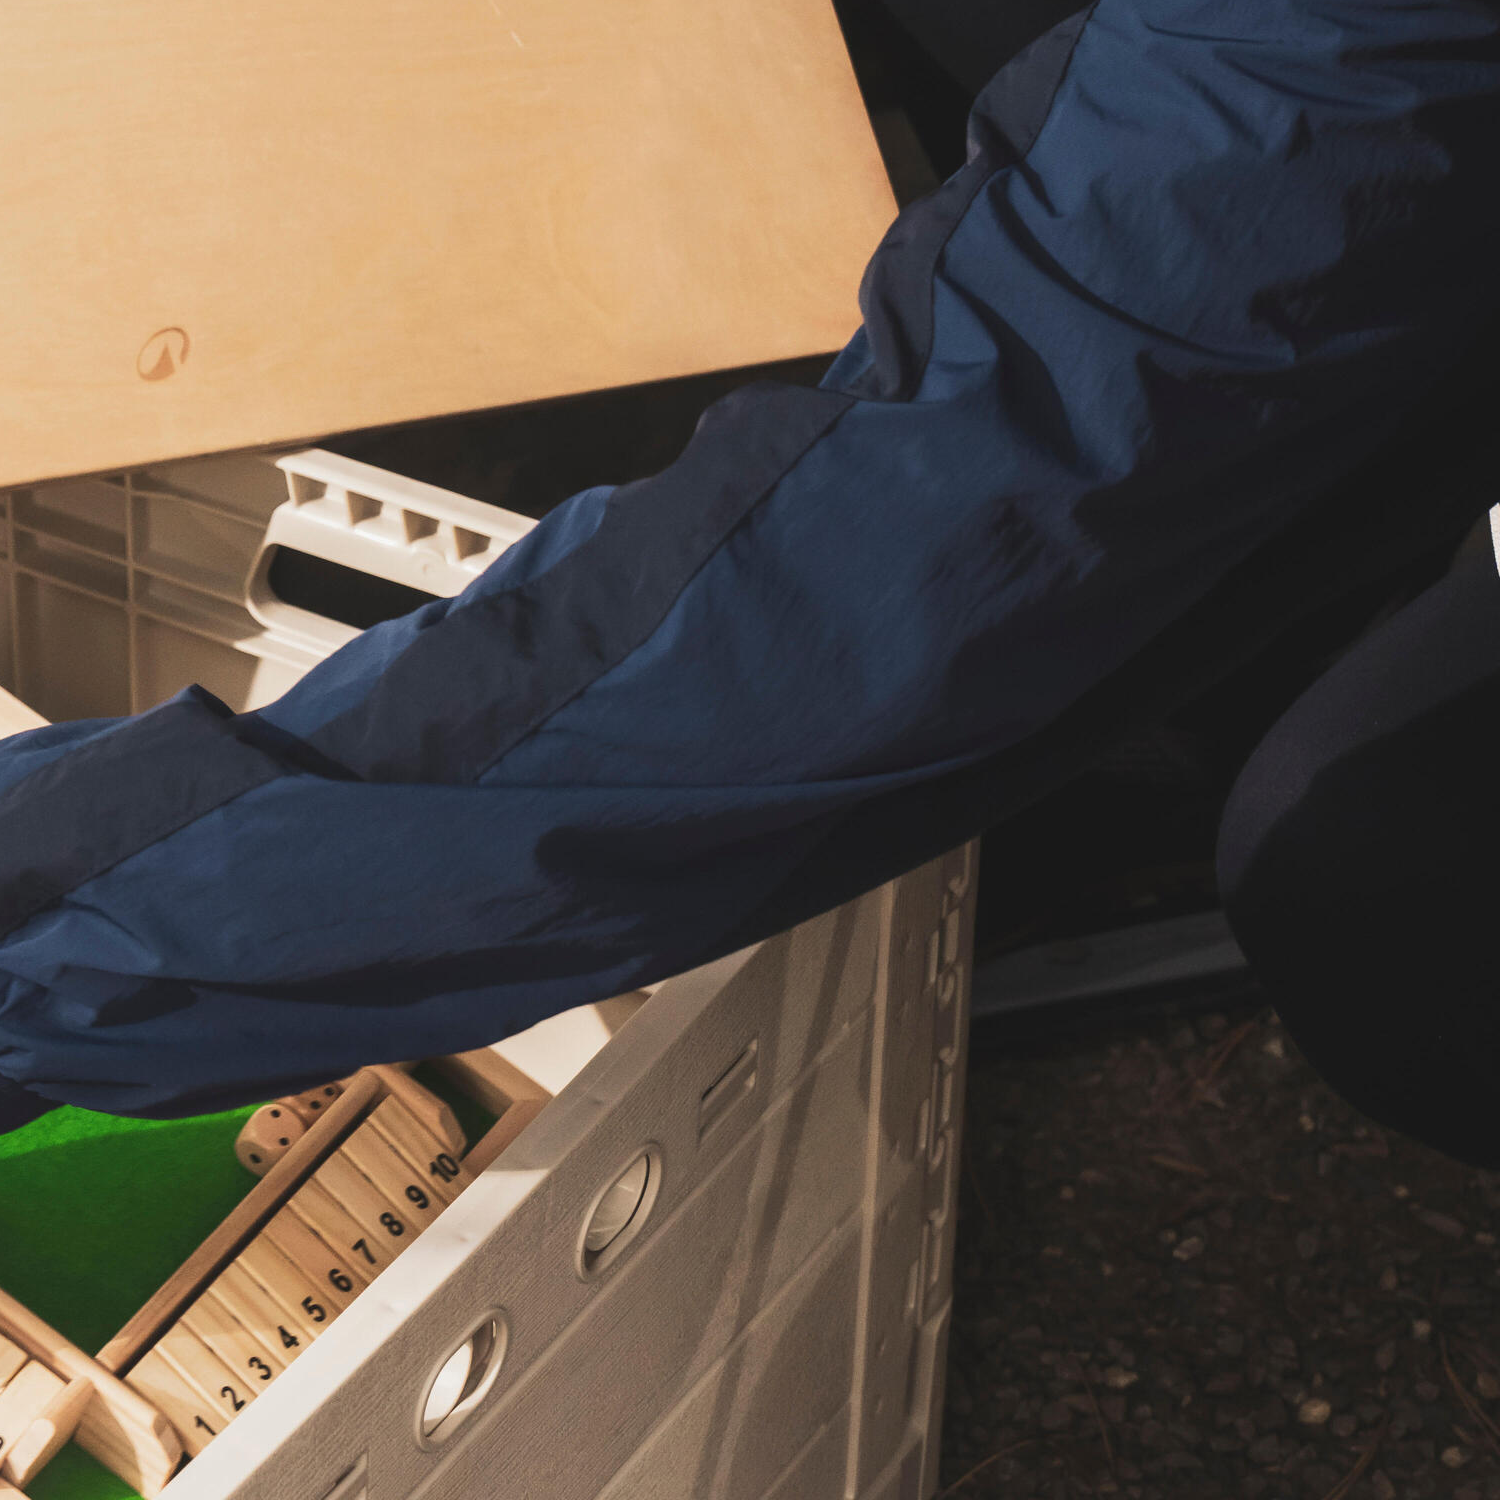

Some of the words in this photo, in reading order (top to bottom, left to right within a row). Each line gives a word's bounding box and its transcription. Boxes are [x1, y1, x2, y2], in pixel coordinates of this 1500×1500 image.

[194, 1415, 217, 1436] 1
[220, 1385, 246, 1412] 2
[248, 1356, 273, 1381] 3
[277, 1325, 300, 1350] 4
[300, 1296, 327, 1323] 5
[328, 1268, 354, 1293] 6
[352, 1238, 377, 1265] 7
[380, 1211, 405, 1237] 8
[405, 1185, 431, 1210] 9
[430, 1152, 461, 1184] 10
